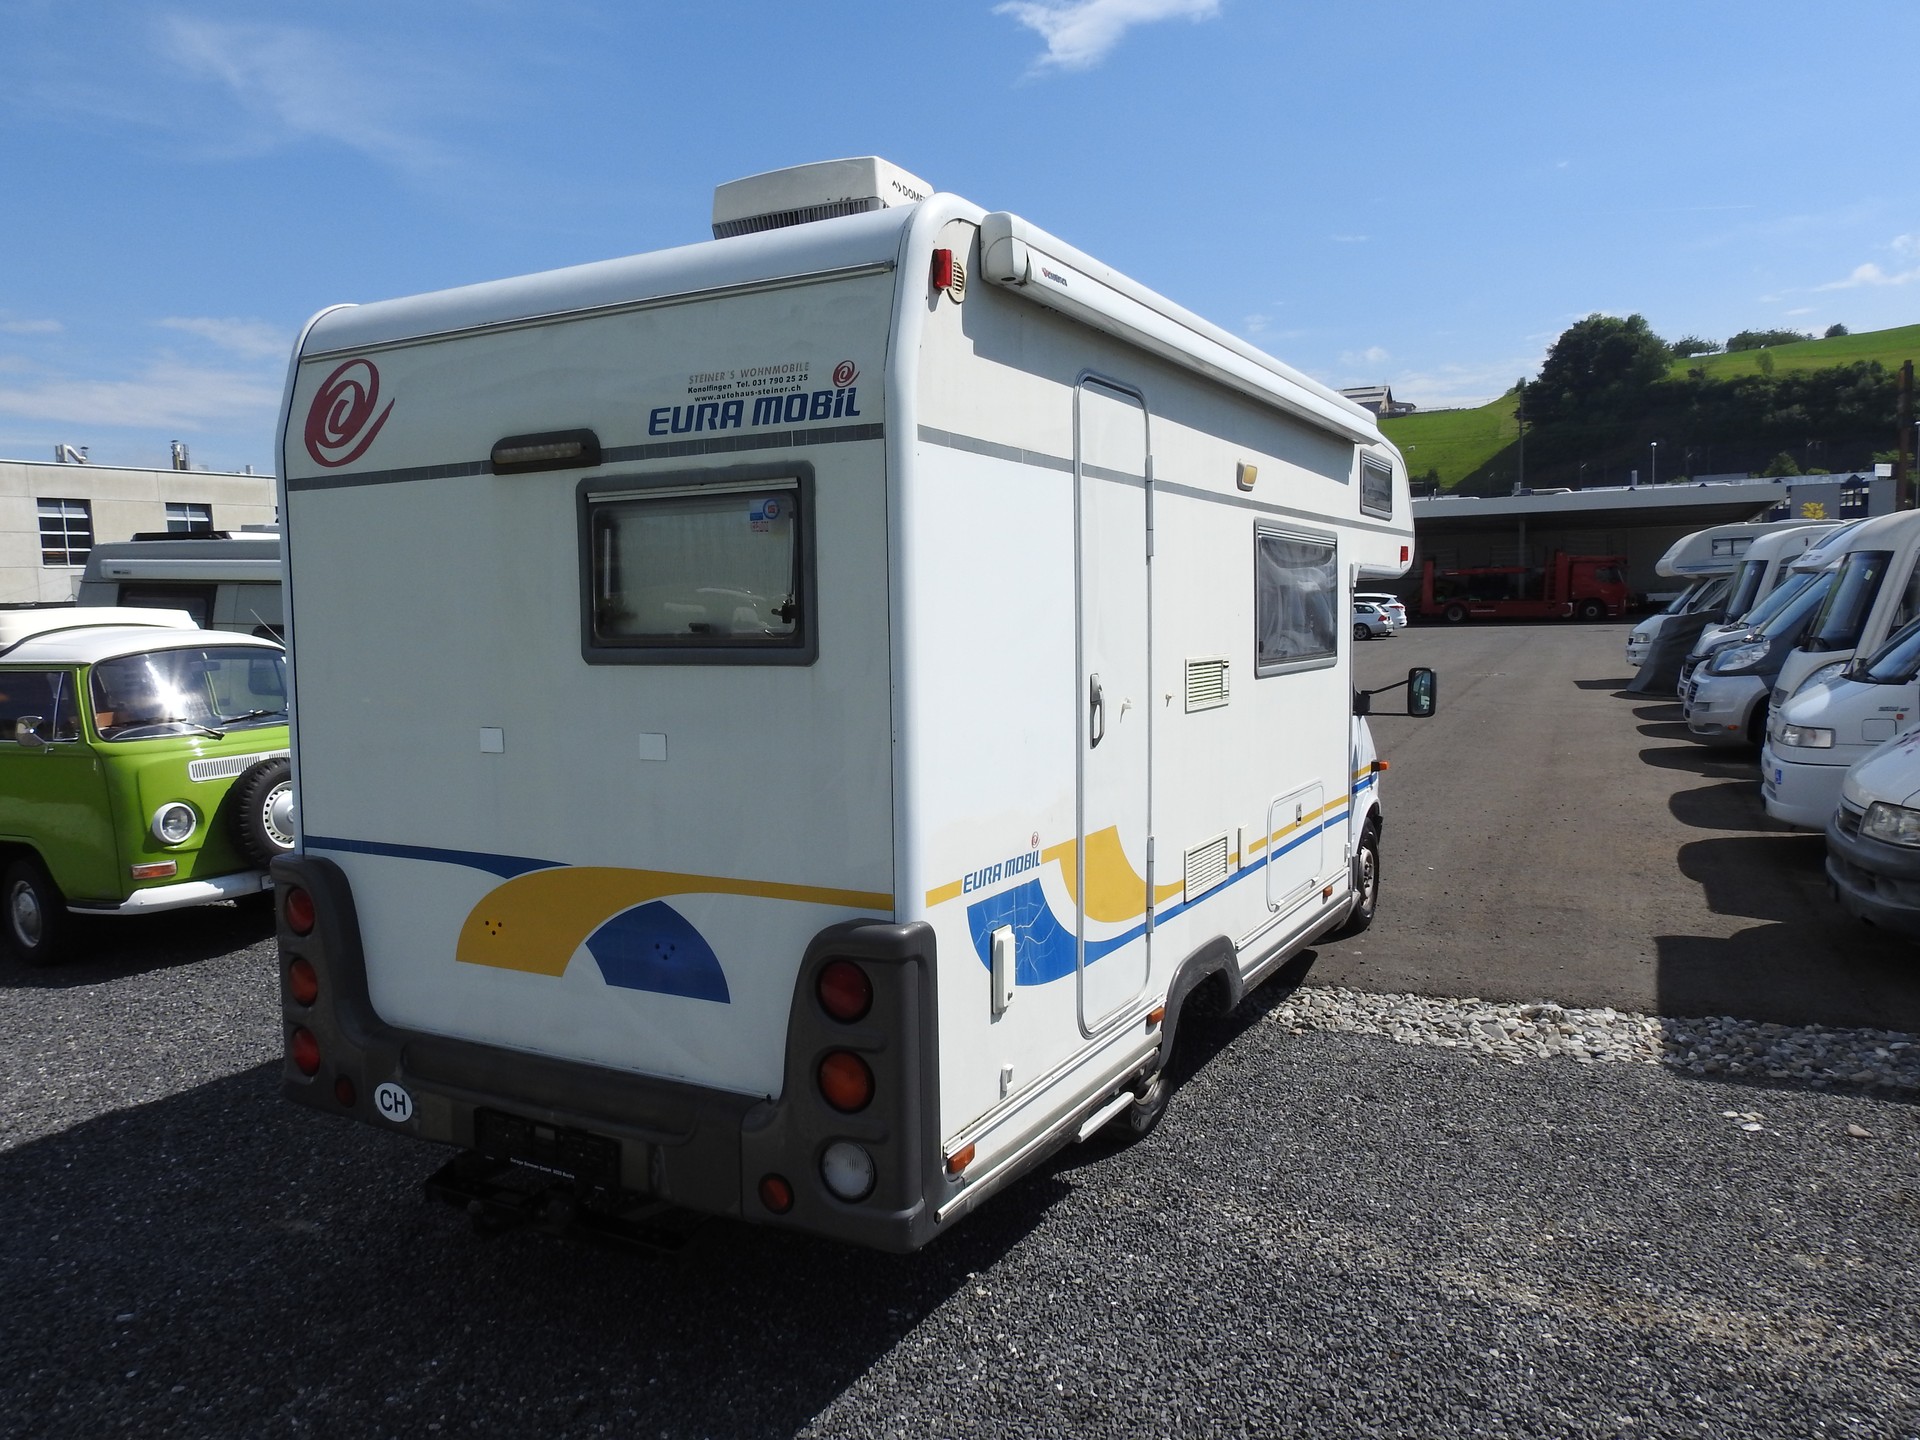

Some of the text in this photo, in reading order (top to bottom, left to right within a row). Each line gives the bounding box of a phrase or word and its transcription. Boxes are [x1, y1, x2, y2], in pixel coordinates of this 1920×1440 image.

[740, 362, 810, 378] WOHNMOBILE
[687, 373, 809, 394] Konolfingen Tel. 031 790 25 25
[694, 384, 801, 402] www.autohaus-steiner.ch
[648, 400, 744, 435] EURA
[963, 850, 1040, 894] EURA MOBIL
[380, 1089, 406, 1115] CH
